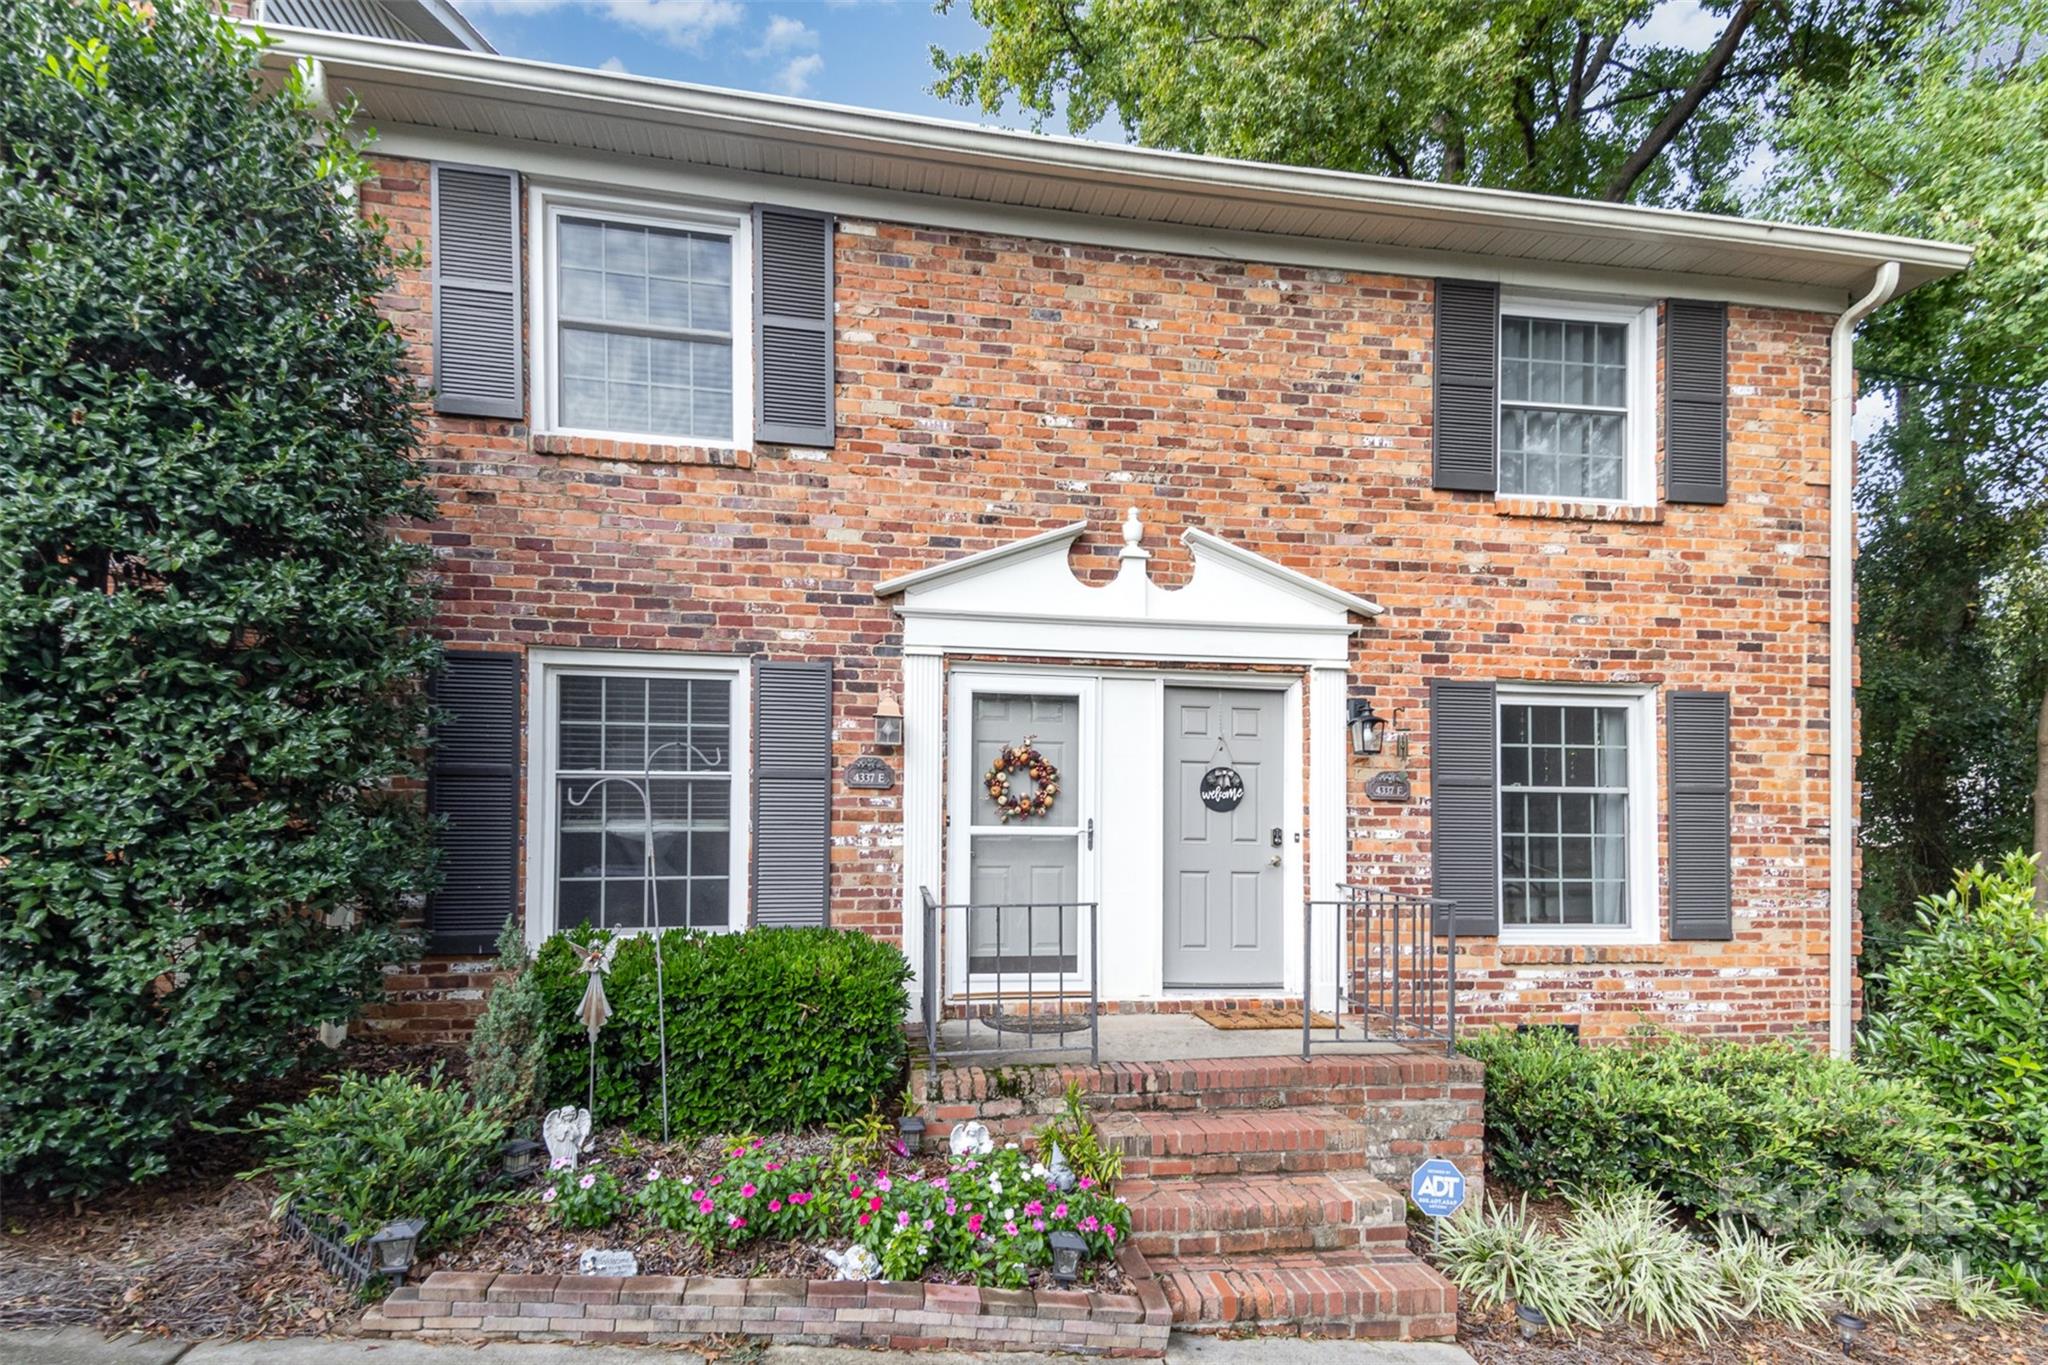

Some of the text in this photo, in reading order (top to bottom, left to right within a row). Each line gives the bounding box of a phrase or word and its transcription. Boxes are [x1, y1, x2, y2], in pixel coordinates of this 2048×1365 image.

[853, 773, 885, 783] 4337 E
[1375, 786, 1394, 795] 4337
[1418, 1175, 1460, 1198] ADT
